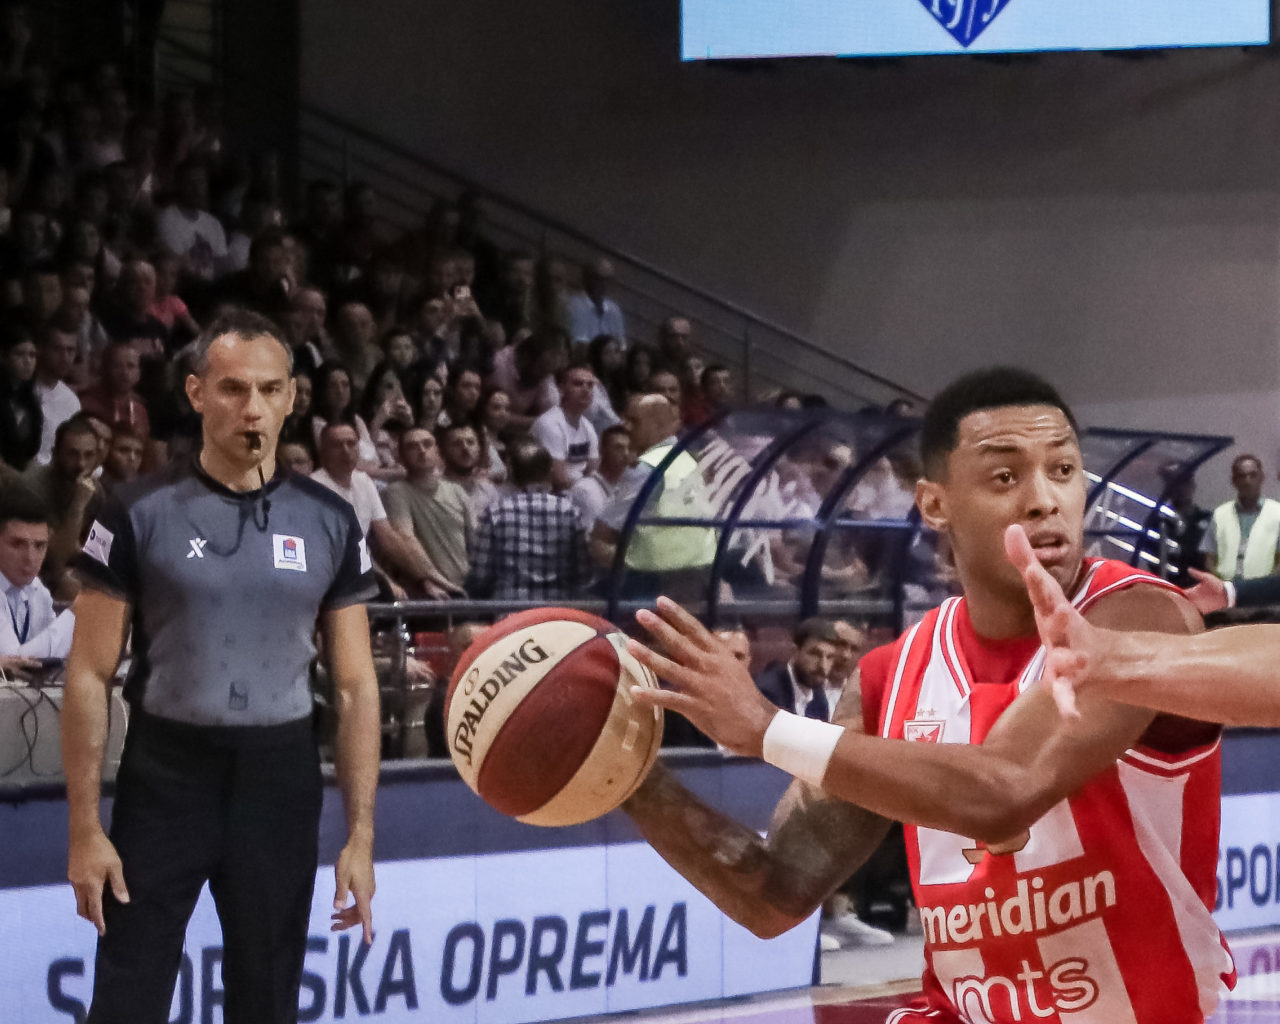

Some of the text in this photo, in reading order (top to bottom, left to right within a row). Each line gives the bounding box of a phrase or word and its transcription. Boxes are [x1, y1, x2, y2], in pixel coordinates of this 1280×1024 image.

[453, 637, 550, 768] SPALDING
[920, 869, 1117, 944] meridian
[440, 901, 688, 1006] OPREMA
[953, 956, 1100, 1022] mts
